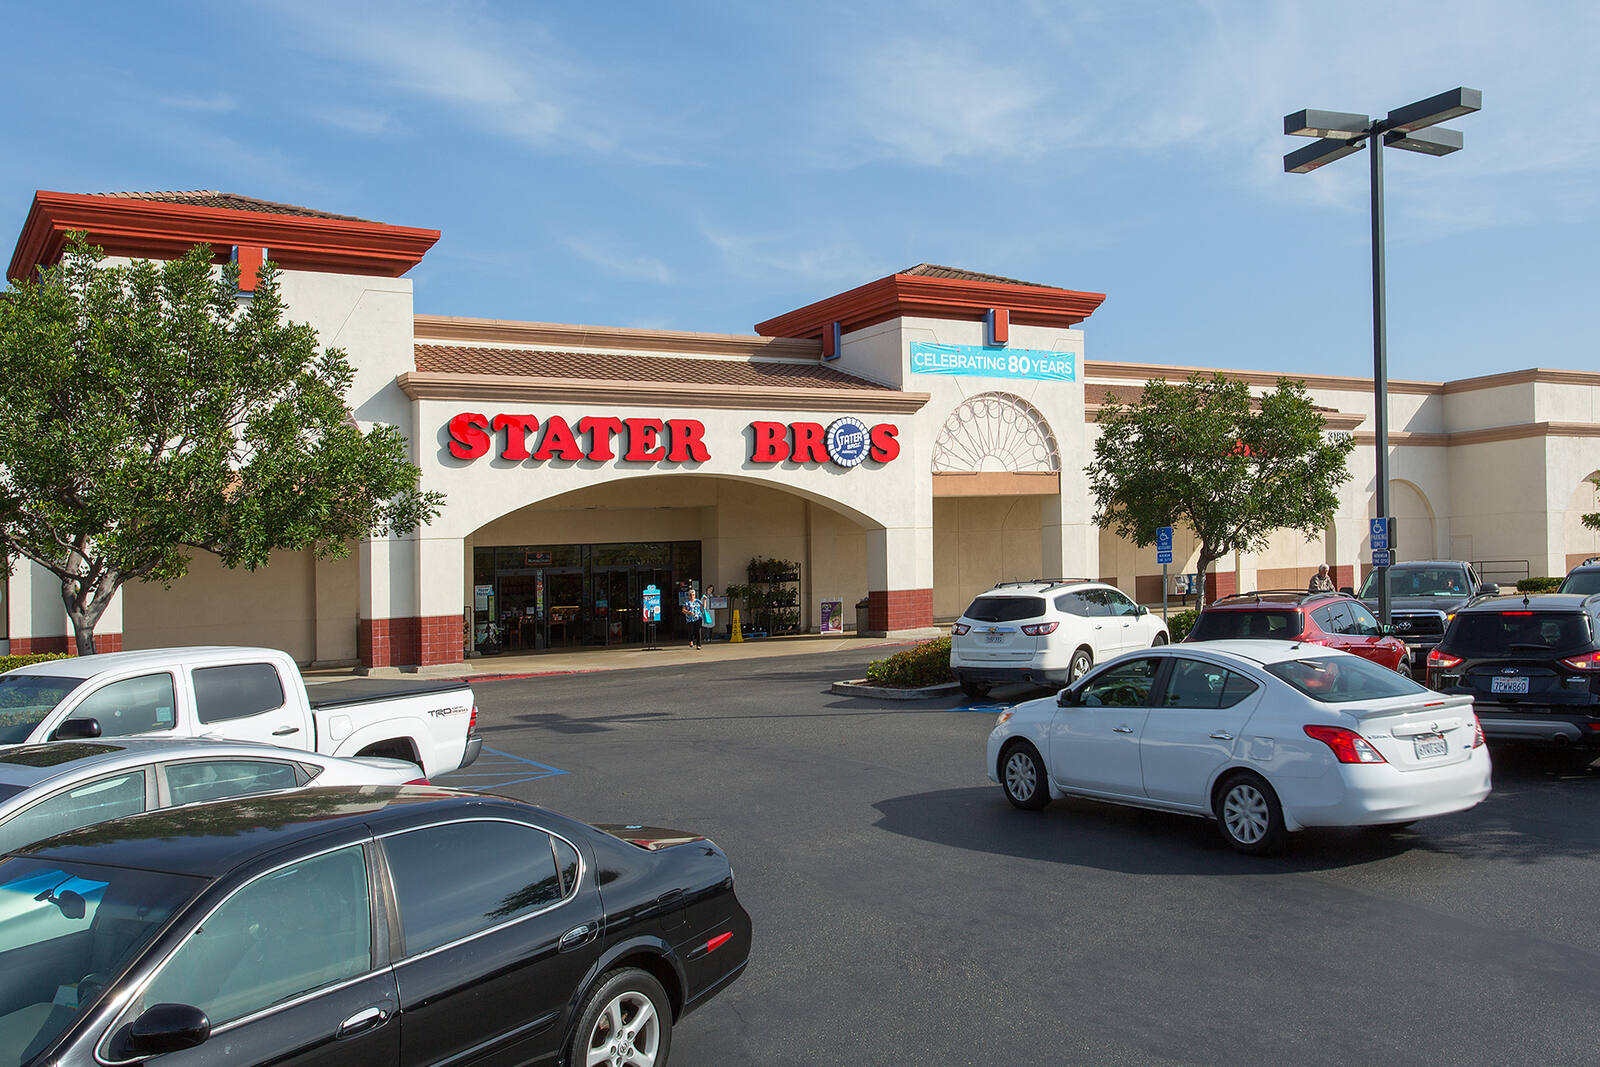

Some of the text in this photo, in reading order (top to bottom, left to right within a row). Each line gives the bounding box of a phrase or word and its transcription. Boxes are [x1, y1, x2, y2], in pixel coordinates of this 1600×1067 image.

[914, 352, 1073, 375] CELEBRATING 80 YEARS
[447, 412, 711, 463] STATER
[836, 429, 862, 451] STATER
[427, 707, 452, 717] TRD
